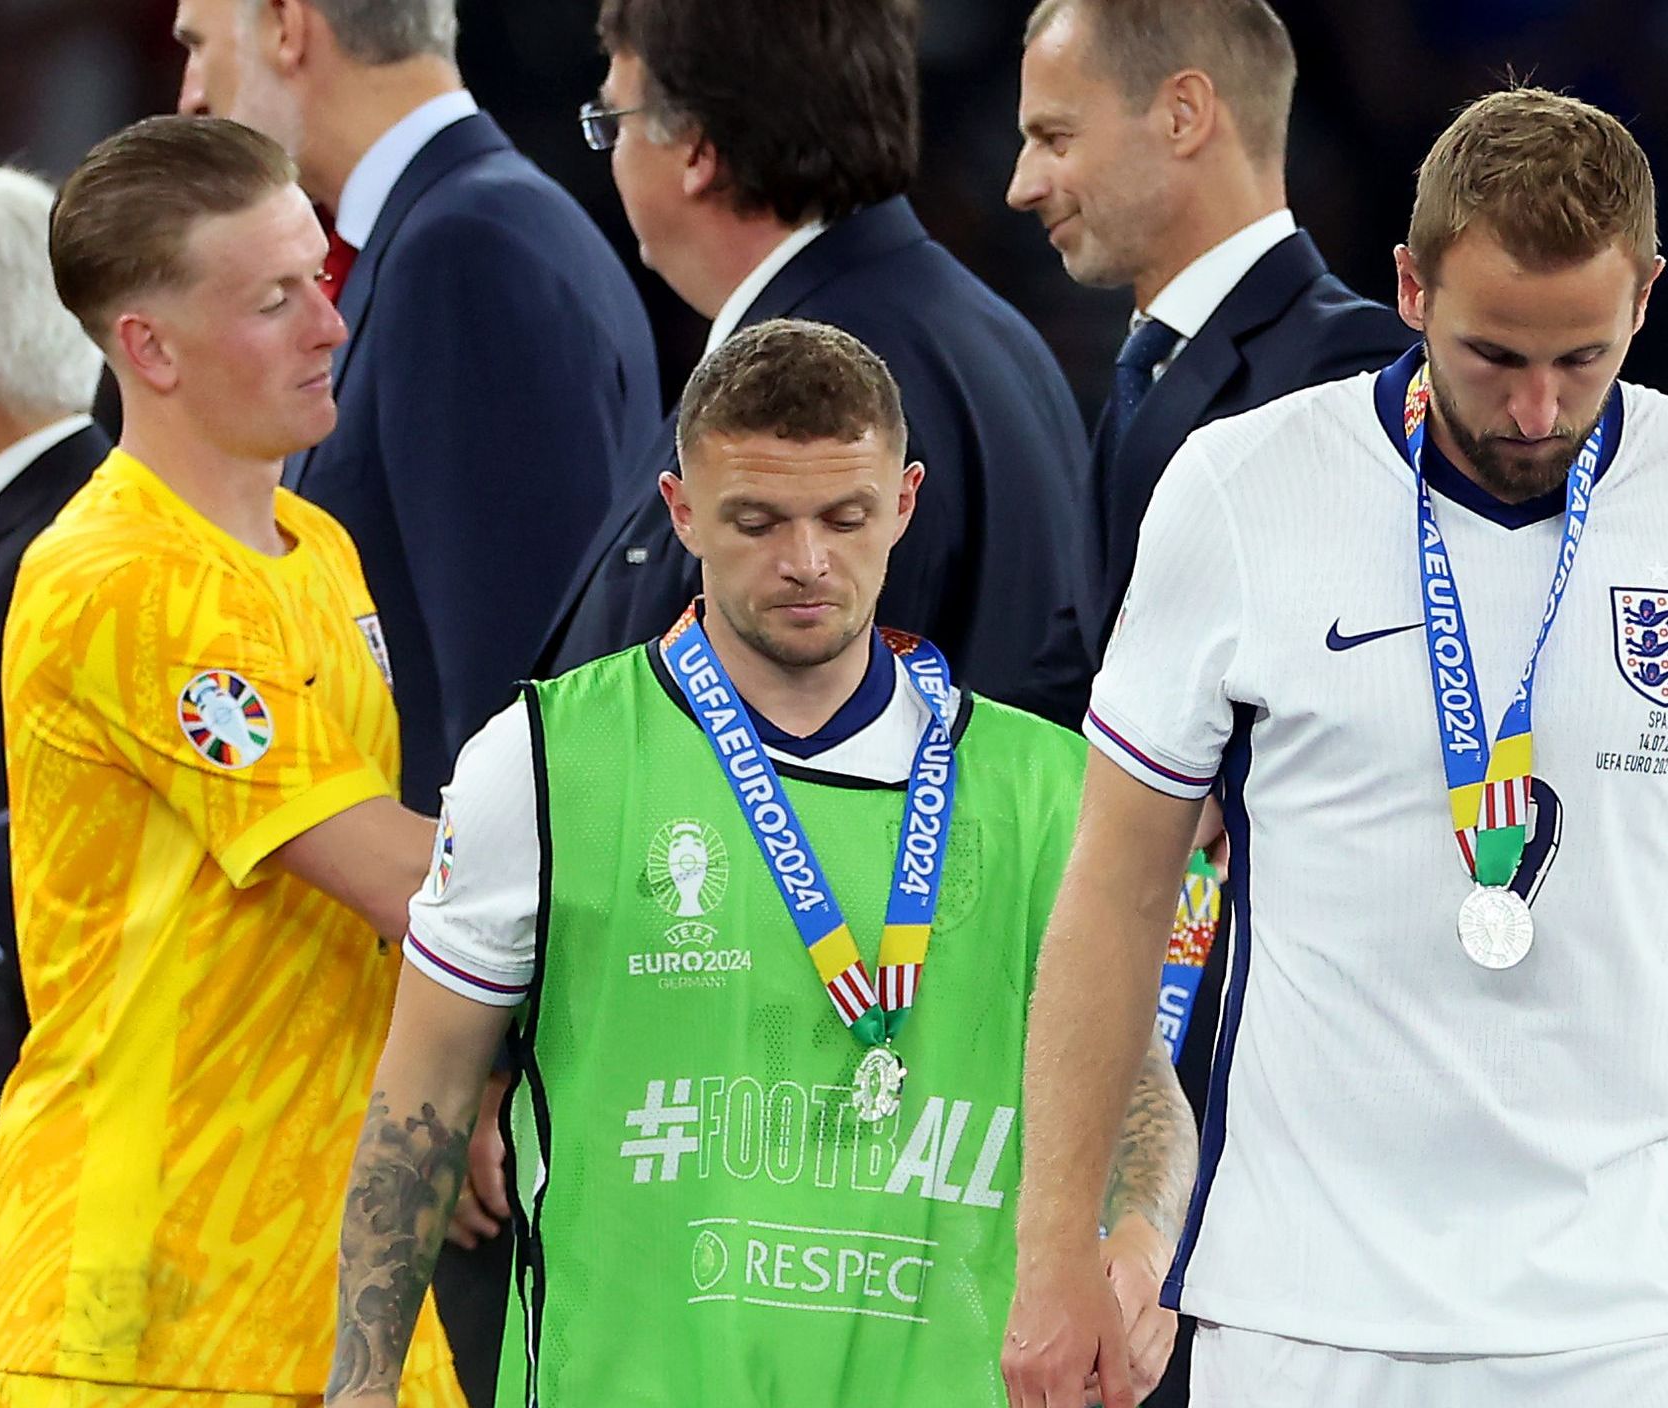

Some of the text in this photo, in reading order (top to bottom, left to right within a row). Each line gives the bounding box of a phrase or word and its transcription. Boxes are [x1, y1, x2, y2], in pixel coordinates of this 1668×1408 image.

[678, 642, 826, 913] UEFAEURO2024
[1595, 751, 1622, 771] UEFA
[1623, 754, 1653, 774] EURO
[628, 948, 752, 976] EURO2024
[665, 926, 714, 946] UEFA
[1158, 983, 1190, 1063] UE
[619, 1075, 1017, 1209] #FOOTBALL
